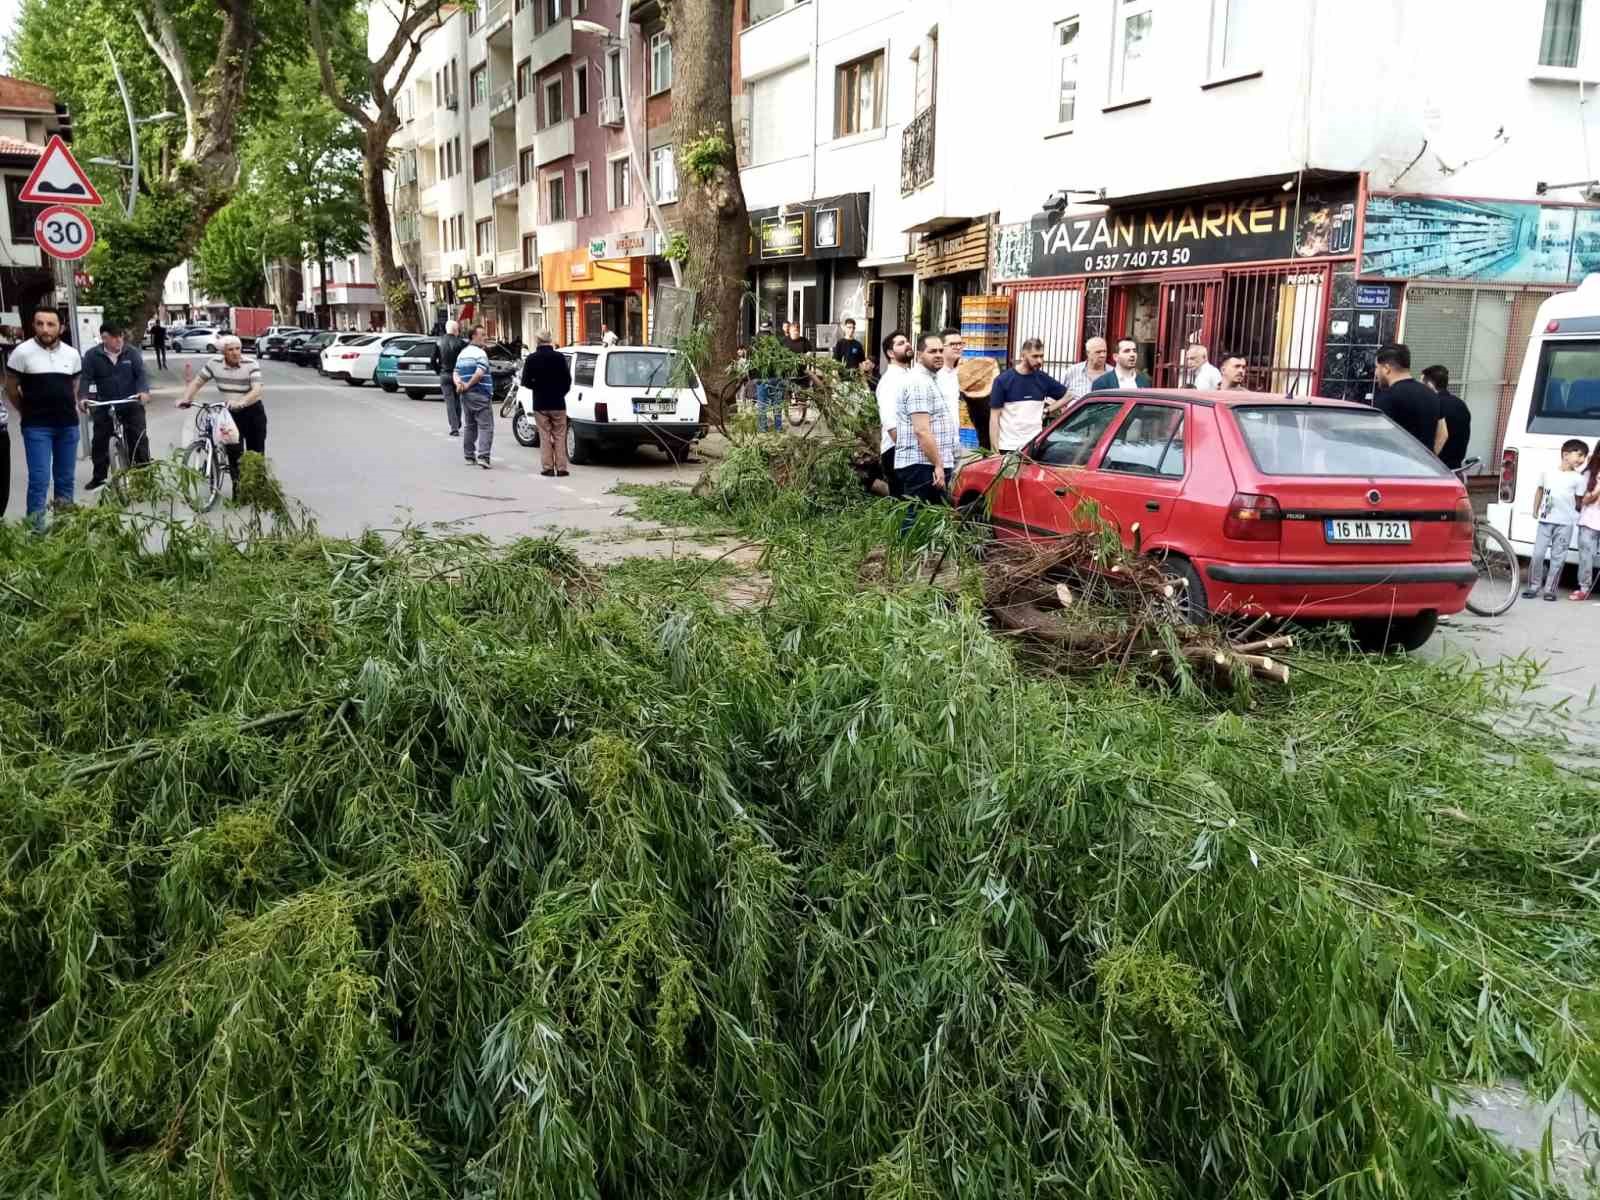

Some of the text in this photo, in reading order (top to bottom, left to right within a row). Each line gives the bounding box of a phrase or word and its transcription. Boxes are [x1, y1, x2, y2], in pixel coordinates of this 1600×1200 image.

[47, 221, 82, 245] 30
[1041, 215, 1135, 255] YAZAN
[1143, 196, 1291, 246] MARKET
[1084, 247, 1190, 271] 0 537 740 73 50
[1336, 523, 1350, 538] 16
[1356, 523, 1372, 538] MA
[1378, 523, 1408, 538] 7321
